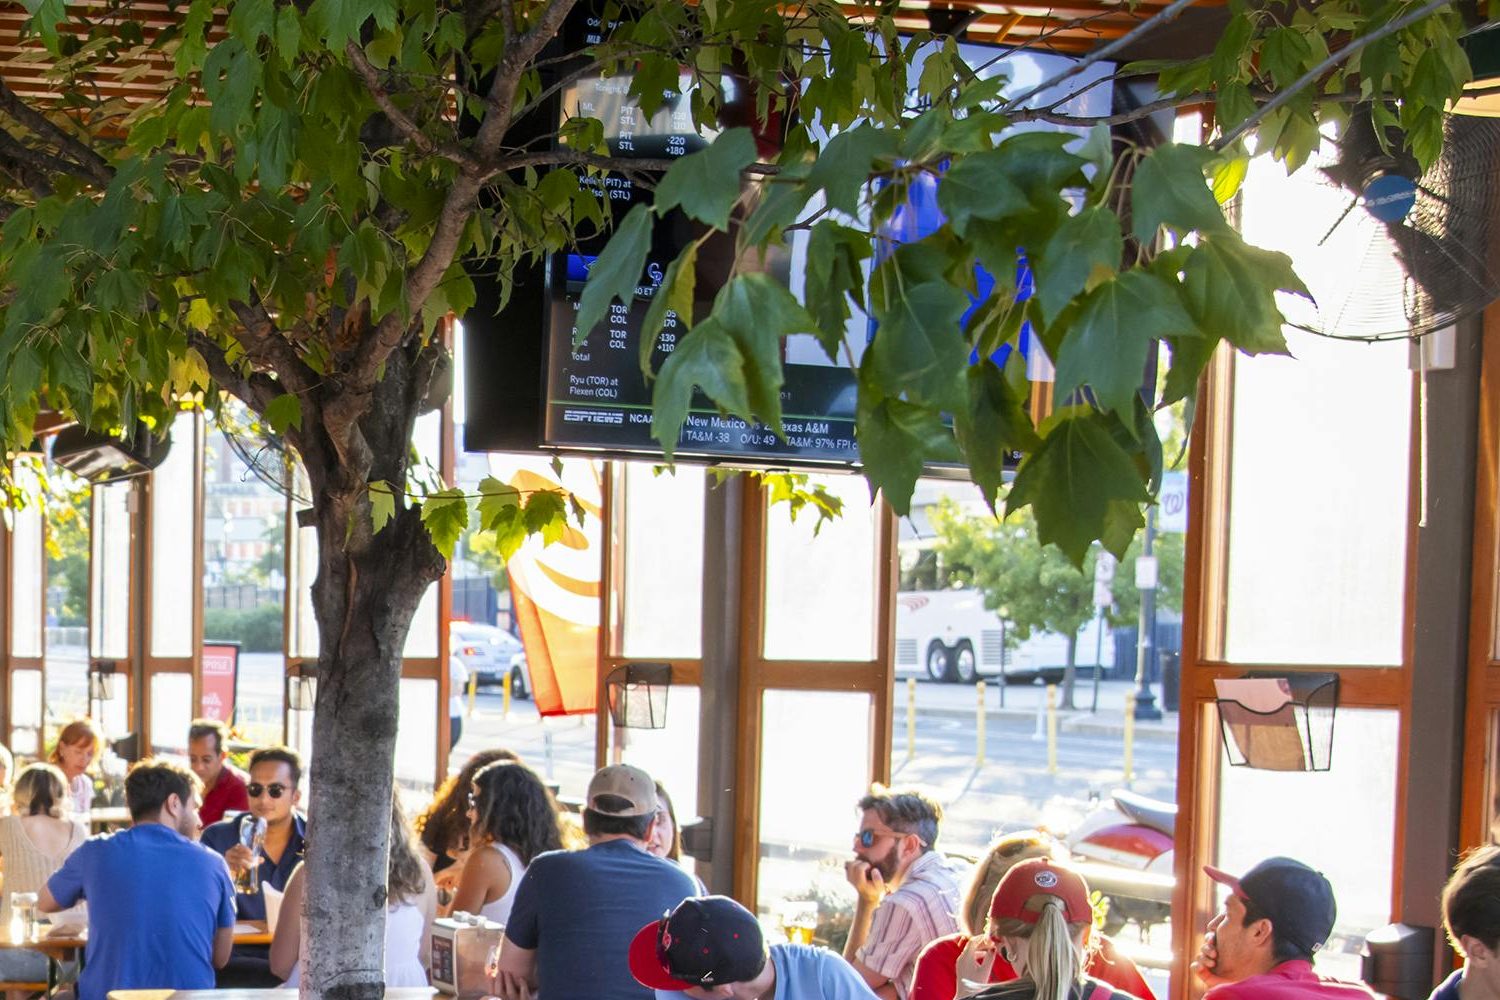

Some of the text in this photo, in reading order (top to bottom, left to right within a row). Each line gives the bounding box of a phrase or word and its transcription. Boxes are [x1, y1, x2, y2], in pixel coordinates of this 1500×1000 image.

[621, 106, 633, 116] PIT
[620, 116, 635, 125] STL
[620, 131, 685, 146] PIT -220
[619, 141, 685, 155] STL +180
[609, 190, 631, 201] (STL)
[612, 305, 627, 314] TOR
[610, 315, 627, 324] COL
[610, 330, 626, 339] TOR
[609, 340, 626, 349] COL
[657, 343, 675, 352] +110
[571, 352, 590, 361] Total
[570, 374, 618, 387] Ryu (TOR) at
[569, 387, 617, 399] Flexen (COL)
[686, 416, 708, 428] New
[710, 417, 746, 430] Mexico
[780, 420, 802, 433] exas
[805, 423, 829, 435] A&M
[686, 430, 713, 442] TA&M
[715, 432, 730, 443] -38
[740, 433, 761, 445] O/U:
[763, 435, 775, 446] 49
[815, 437, 835, 449] 97%
[837, 439, 851, 450] FPI
[1162, 491, 1184, 516] W
